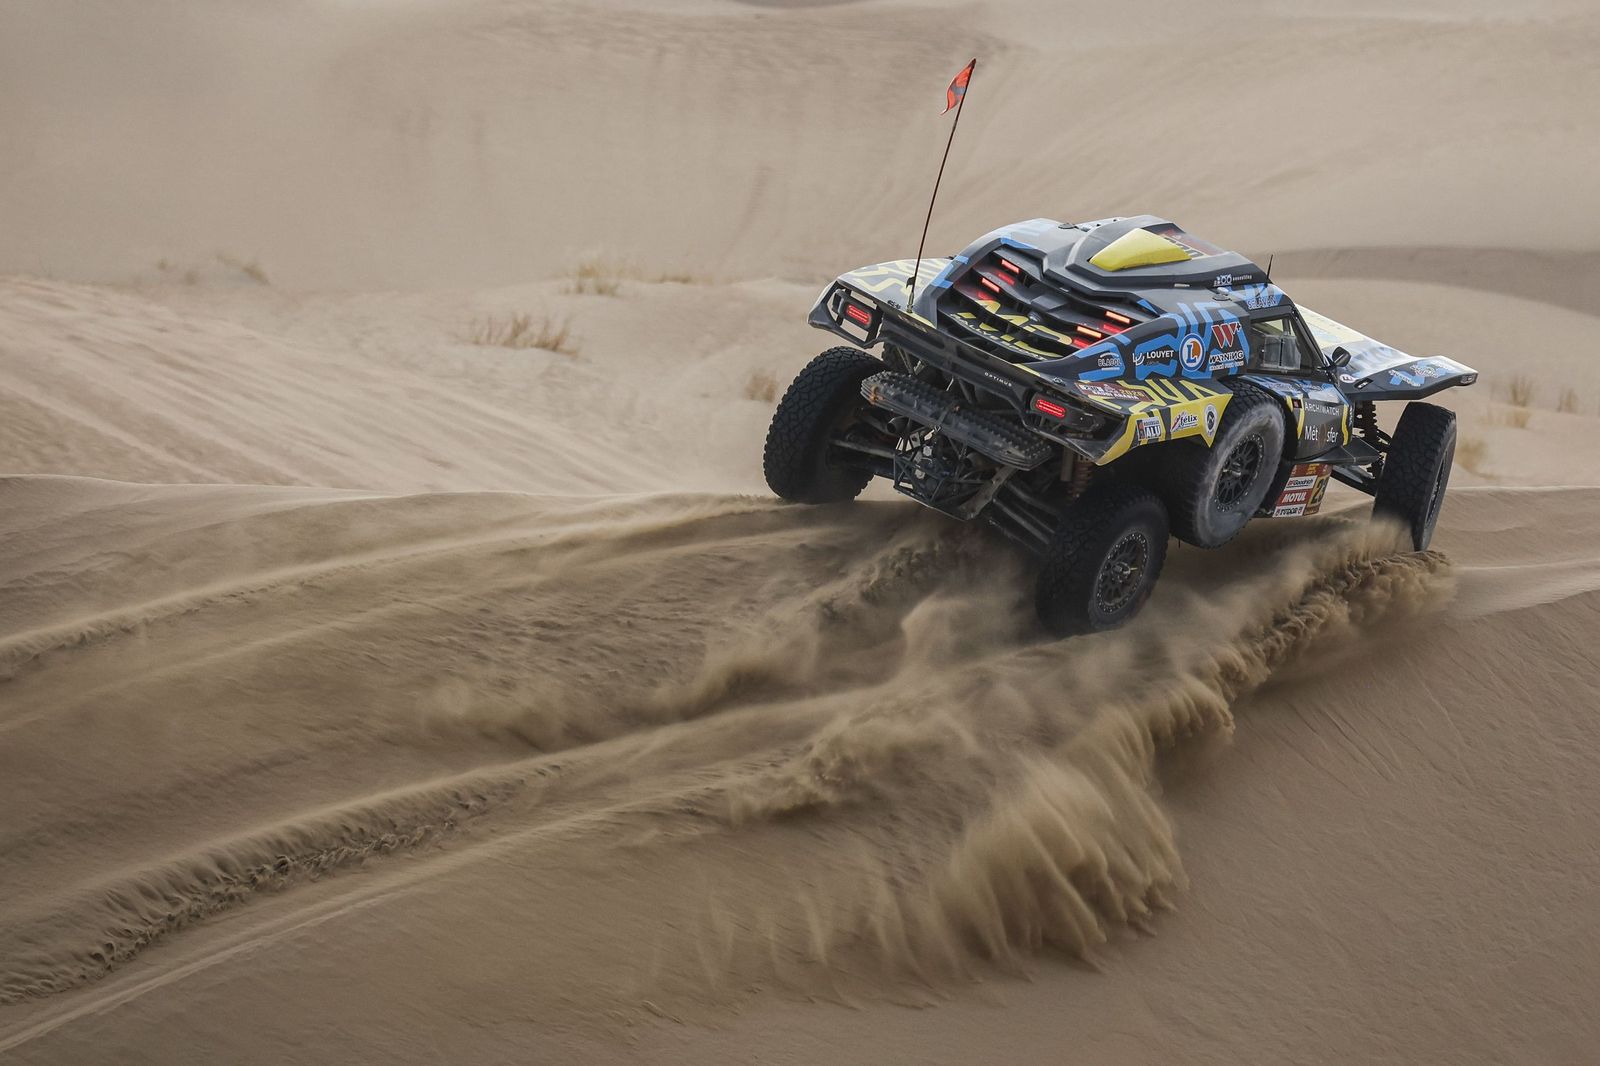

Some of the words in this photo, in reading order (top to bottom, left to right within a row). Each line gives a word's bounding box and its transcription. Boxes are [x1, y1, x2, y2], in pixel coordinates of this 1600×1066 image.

[1147, 350, 1174, 359] LOUYET
[984, 371, 1012, 387] OPTIMUS
[1180, 414, 1198, 427] félix
[1145, 425, 1161, 438] ALU
[1282, 491, 1307, 503] MOTUL
